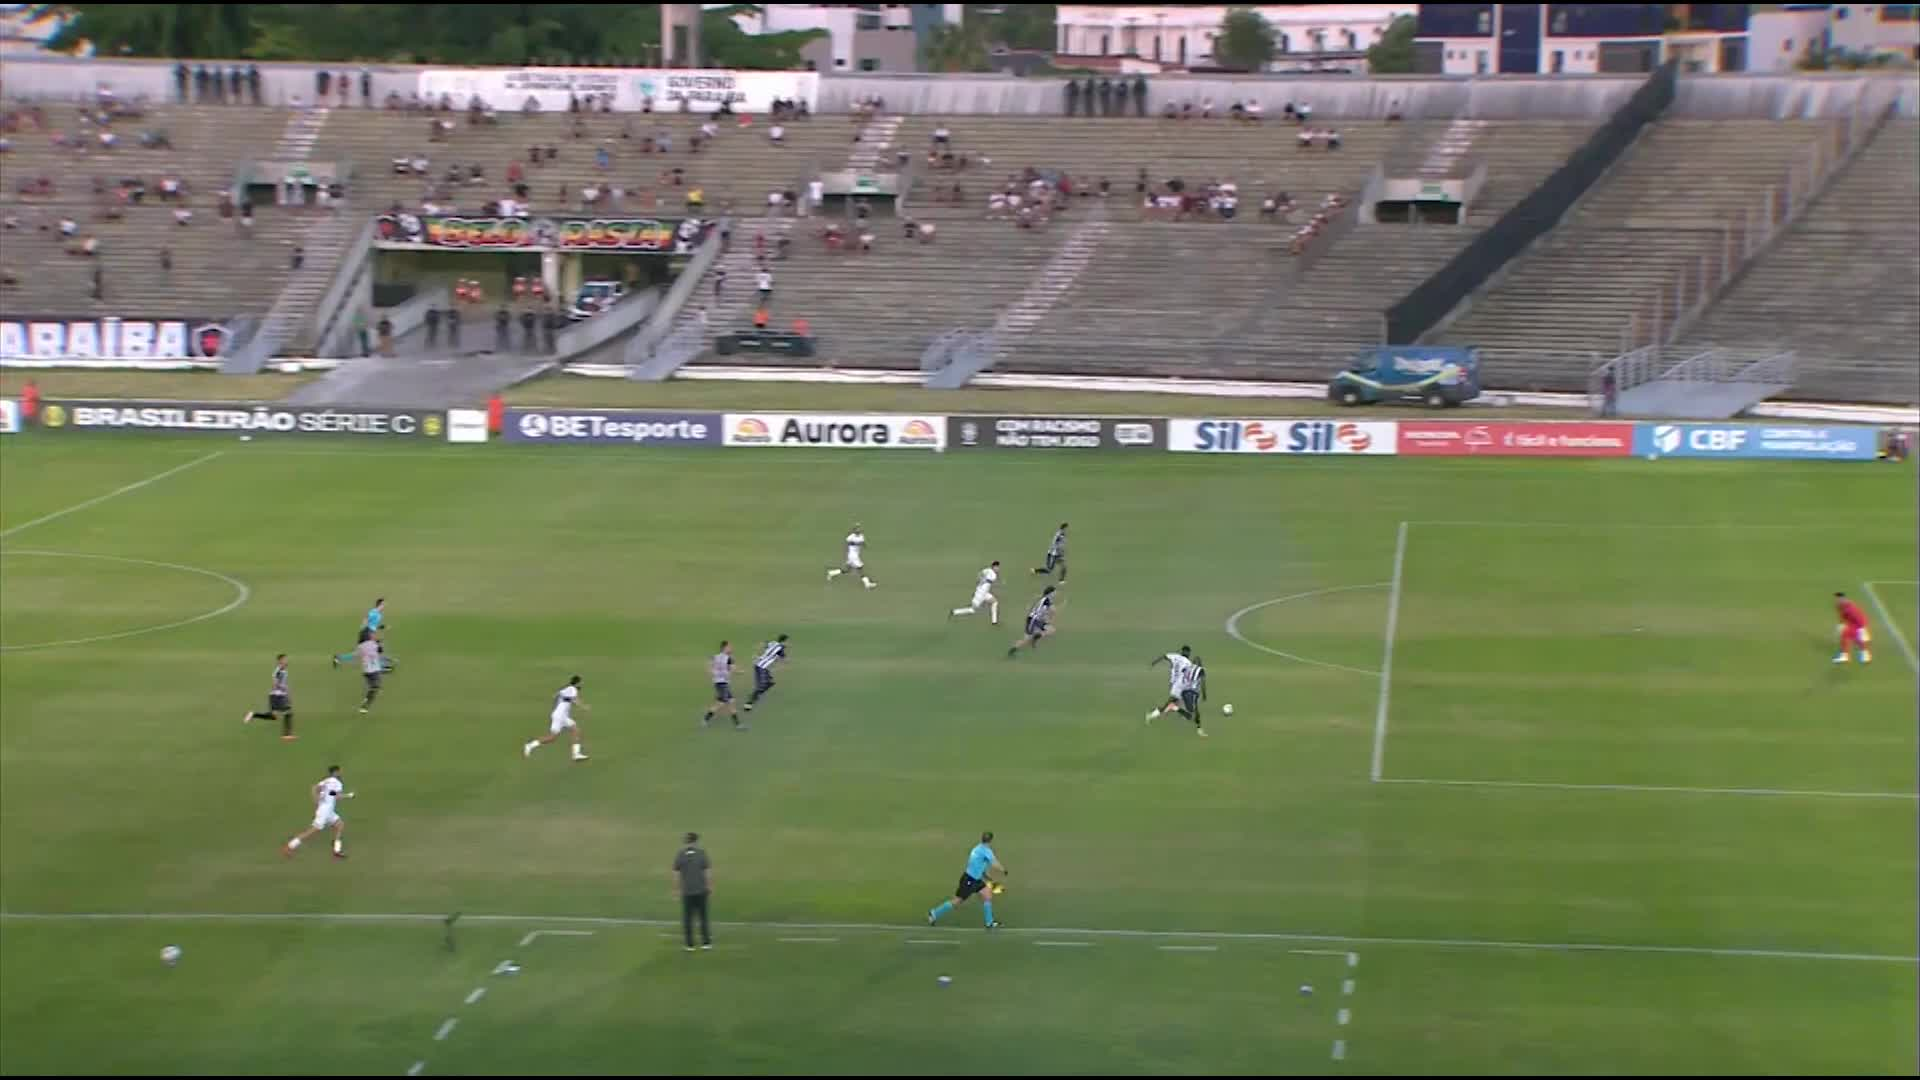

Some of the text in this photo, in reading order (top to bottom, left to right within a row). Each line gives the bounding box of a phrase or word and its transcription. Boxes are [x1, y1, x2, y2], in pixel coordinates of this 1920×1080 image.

[73, 407, 416, 433] BRASILEIRÃO SÉRIE C
[550, 416, 708, 441] BETesporte
[780, 418, 889, 444] Aurora
[996, 432, 1029, 446] NÃO
[1195, 421, 1333, 451] Sil Sil
[1690, 429, 1748, 451] CBF
